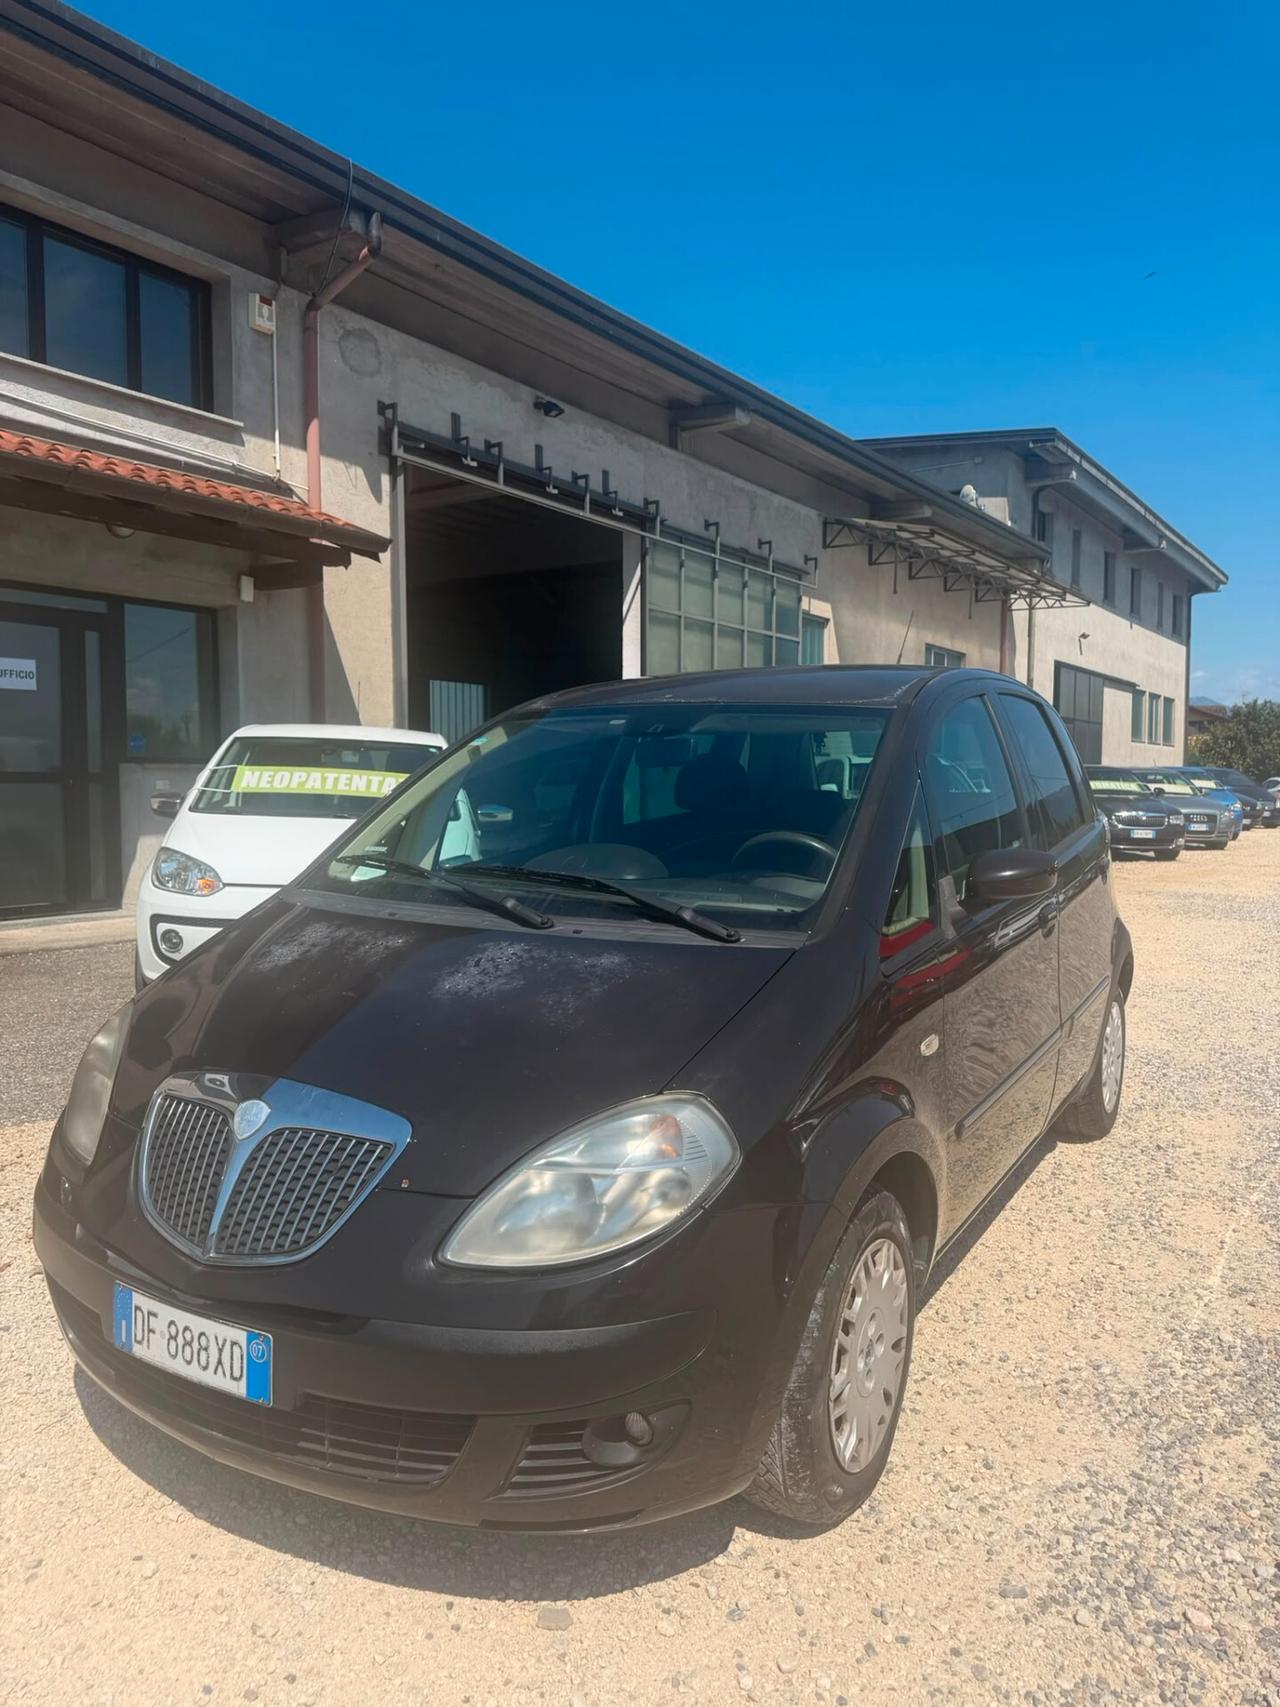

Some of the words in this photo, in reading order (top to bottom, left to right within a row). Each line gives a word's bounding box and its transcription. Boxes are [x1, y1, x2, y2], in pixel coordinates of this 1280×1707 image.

[241, 770, 405, 794] NEOPATENTA
[134, 1305, 159, 1350] DF
[167, 1320, 244, 1382] 888XD
